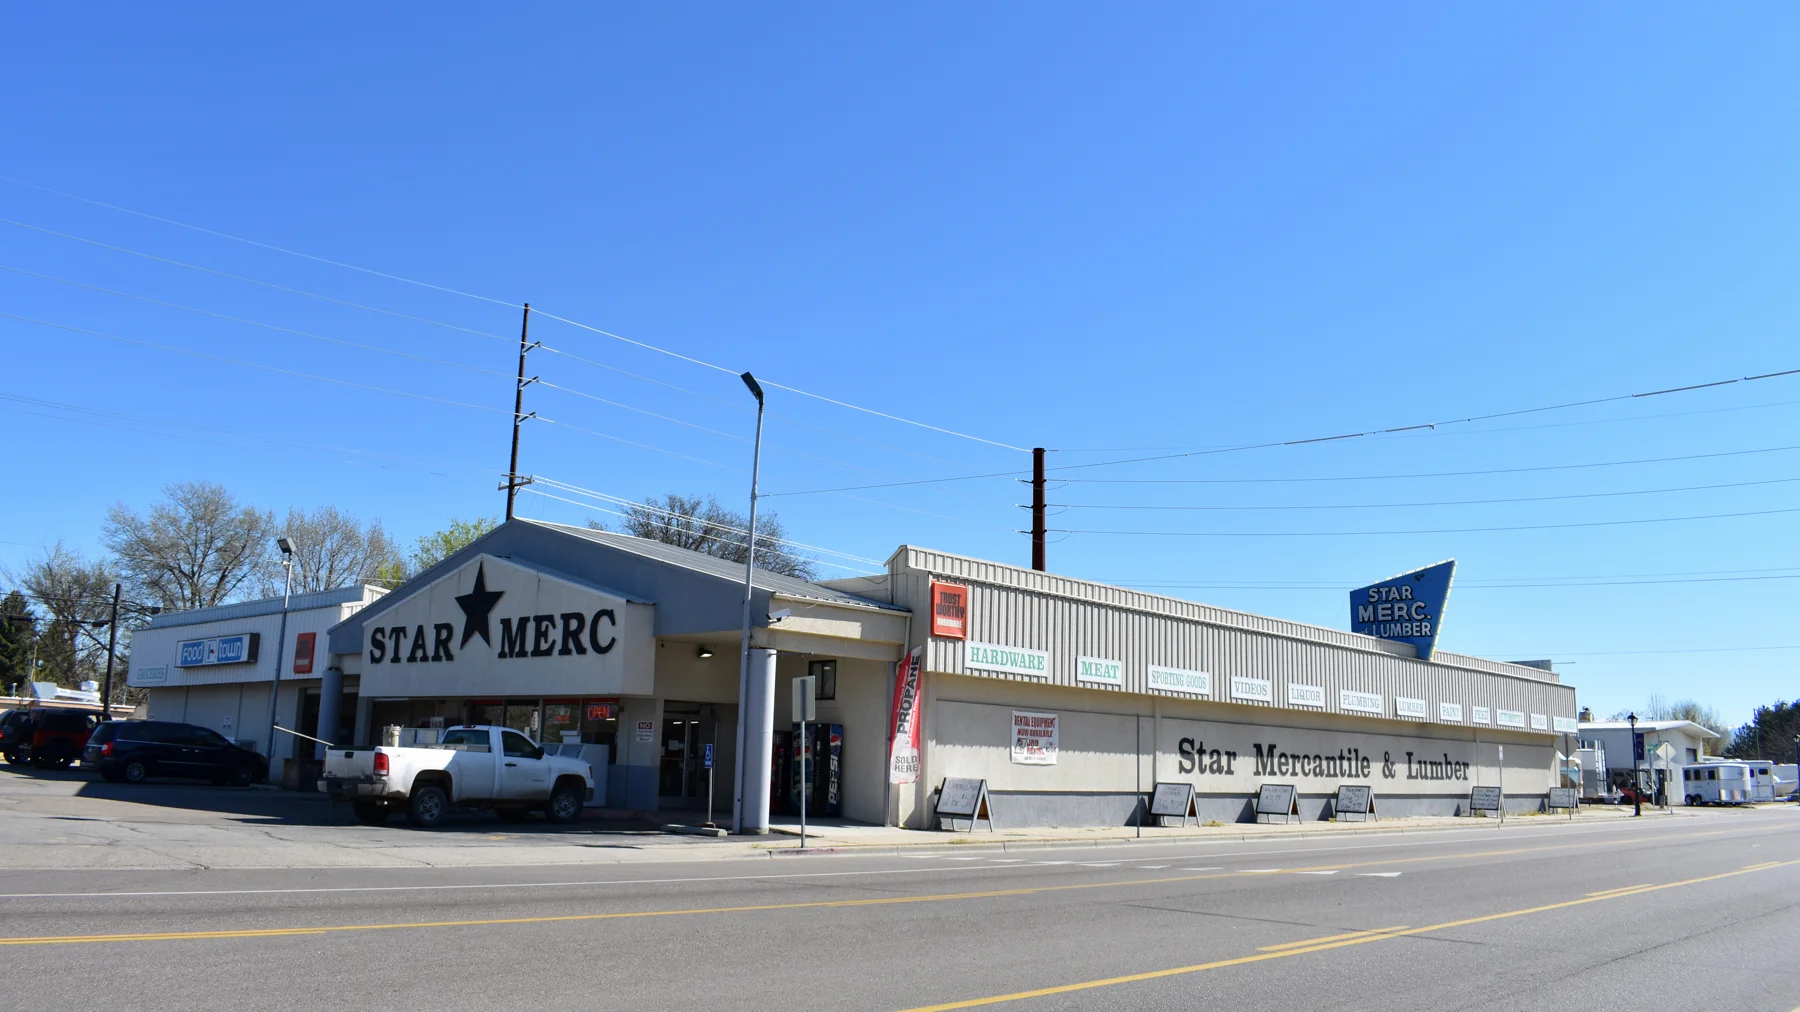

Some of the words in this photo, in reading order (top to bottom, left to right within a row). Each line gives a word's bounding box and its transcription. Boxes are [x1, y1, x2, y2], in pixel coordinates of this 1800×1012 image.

[939, 591, 962, 606] TRUST
[1368, 585, 1413, 602] STAR
[936, 604, 965, 618] WORTHY
[1358, 601, 1432, 622] MERC.
[370, 622, 454, 664] STAR
[498, 609, 616, 658] MERC
[1372, 622, 1431, 638] LUMBER
[970, 646, 1044, 670] HARDWARE
[1080, 661, 1119, 680] MEAT
[1152, 670, 1184, 688] SPORTING
[1186, 674, 1206, 690] GOODS
[896, 656, 920, 735] PROPANE
[1234, 681, 1268, 696] VIDEOS
[1291, 688, 1321, 702] LIQUOR
[1342, 694, 1380, 710] PLUMBING
[1399, 701, 1424, 714] LUMBER
[588, 705, 610, 720] OPEN
[1442, 706, 1460, 718] PAINT
[1474, 709, 1488, 720] FEED
[1031, 716, 1056, 728] EQUIPMENT
[1017, 728, 1028, 736] NOW
[895, 756, 918, 764] SOLD
[1178, 737, 1237, 775] Star
[1253, 743, 1371, 778] Mercantile
[1382, 751, 1396, 780] &
[1406, 752, 1469, 780] Lumber
[894, 764, 918, 772] HERE
